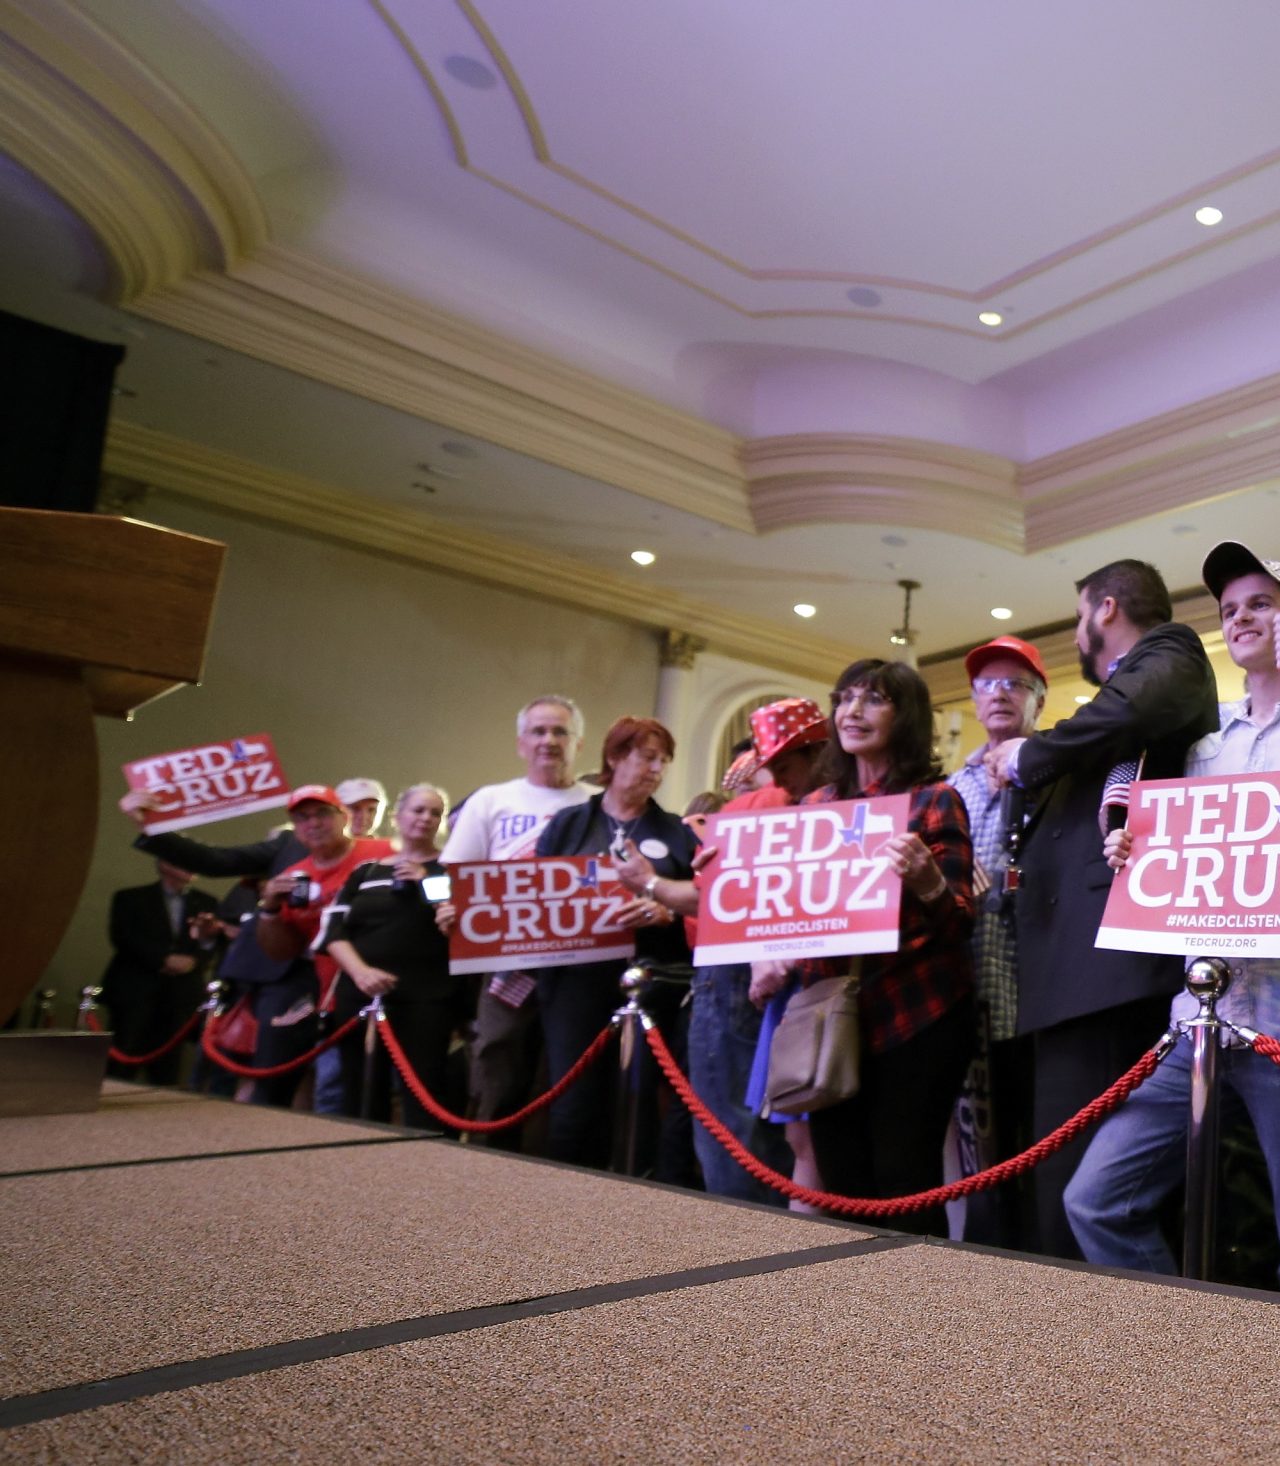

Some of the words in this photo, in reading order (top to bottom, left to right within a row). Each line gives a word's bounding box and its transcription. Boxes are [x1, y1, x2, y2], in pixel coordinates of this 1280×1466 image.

[131, 745, 235, 789] TED
[1140, 781, 1280, 847] TED
[715, 810, 845, 869] TED
[458, 861, 581, 904] TED
[709, 856, 890, 924] CRUZ
[460, 896, 626, 944] CRUZ
[745, 918, 849, 938] #MAKEDCLISTEN
[1184, 936, 1257, 948] TEDCRUZ.ORG
